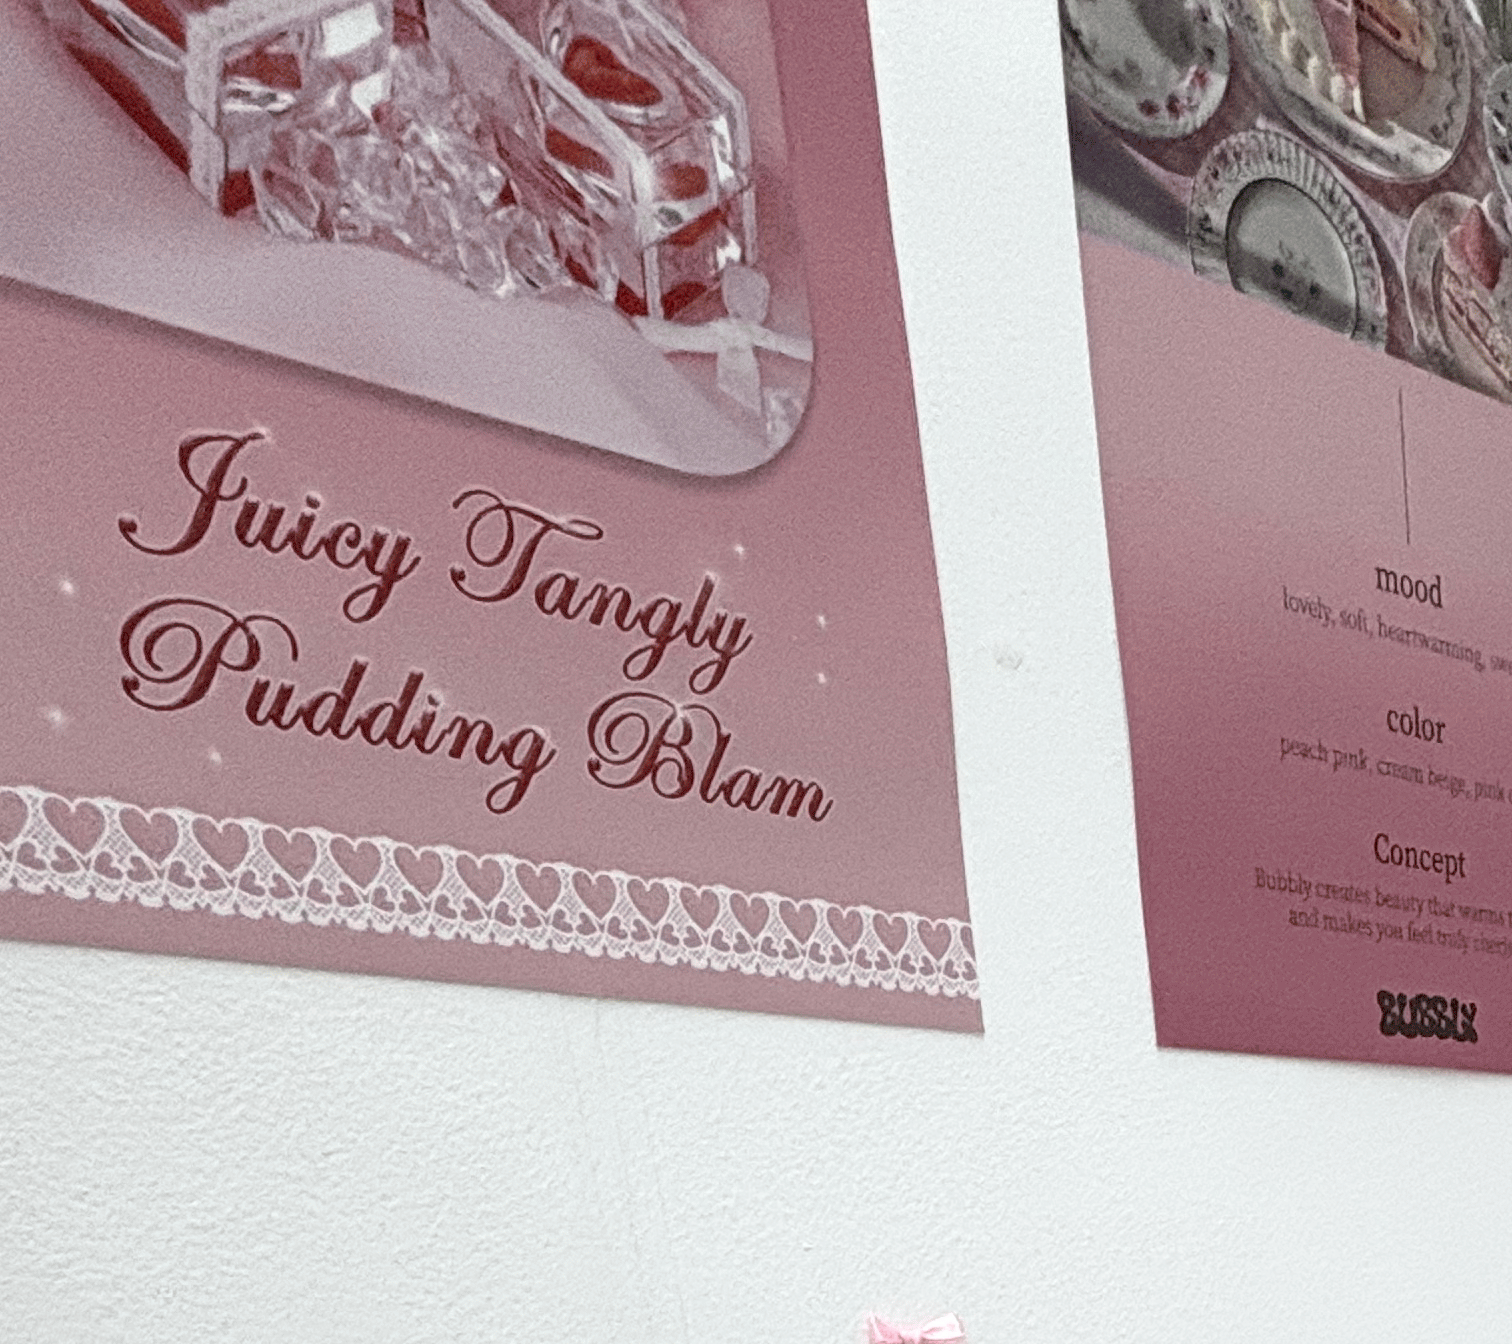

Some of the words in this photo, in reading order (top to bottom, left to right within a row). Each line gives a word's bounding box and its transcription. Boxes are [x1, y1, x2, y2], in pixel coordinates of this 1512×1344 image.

[117, 428, 421, 624] Juicy
[450, 488, 753, 695] Tangly
[1282, 585, 1336, 628] lovely,
[1375, 567, 1443, 608] mood
[117, 597, 558, 816] Pudding
[586, 690, 834, 823] Blam
[1386, 705, 1446, 744] color
[1280, 736, 1328, 761] peach
[1373, 833, 1467, 884] Concept
[1255, 866, 1312, 901] Bubbly
[1289, 906, 1320, 929] and
[1322, 908, 1373, 936] makes
[1375, 920, 1403, 943] you
